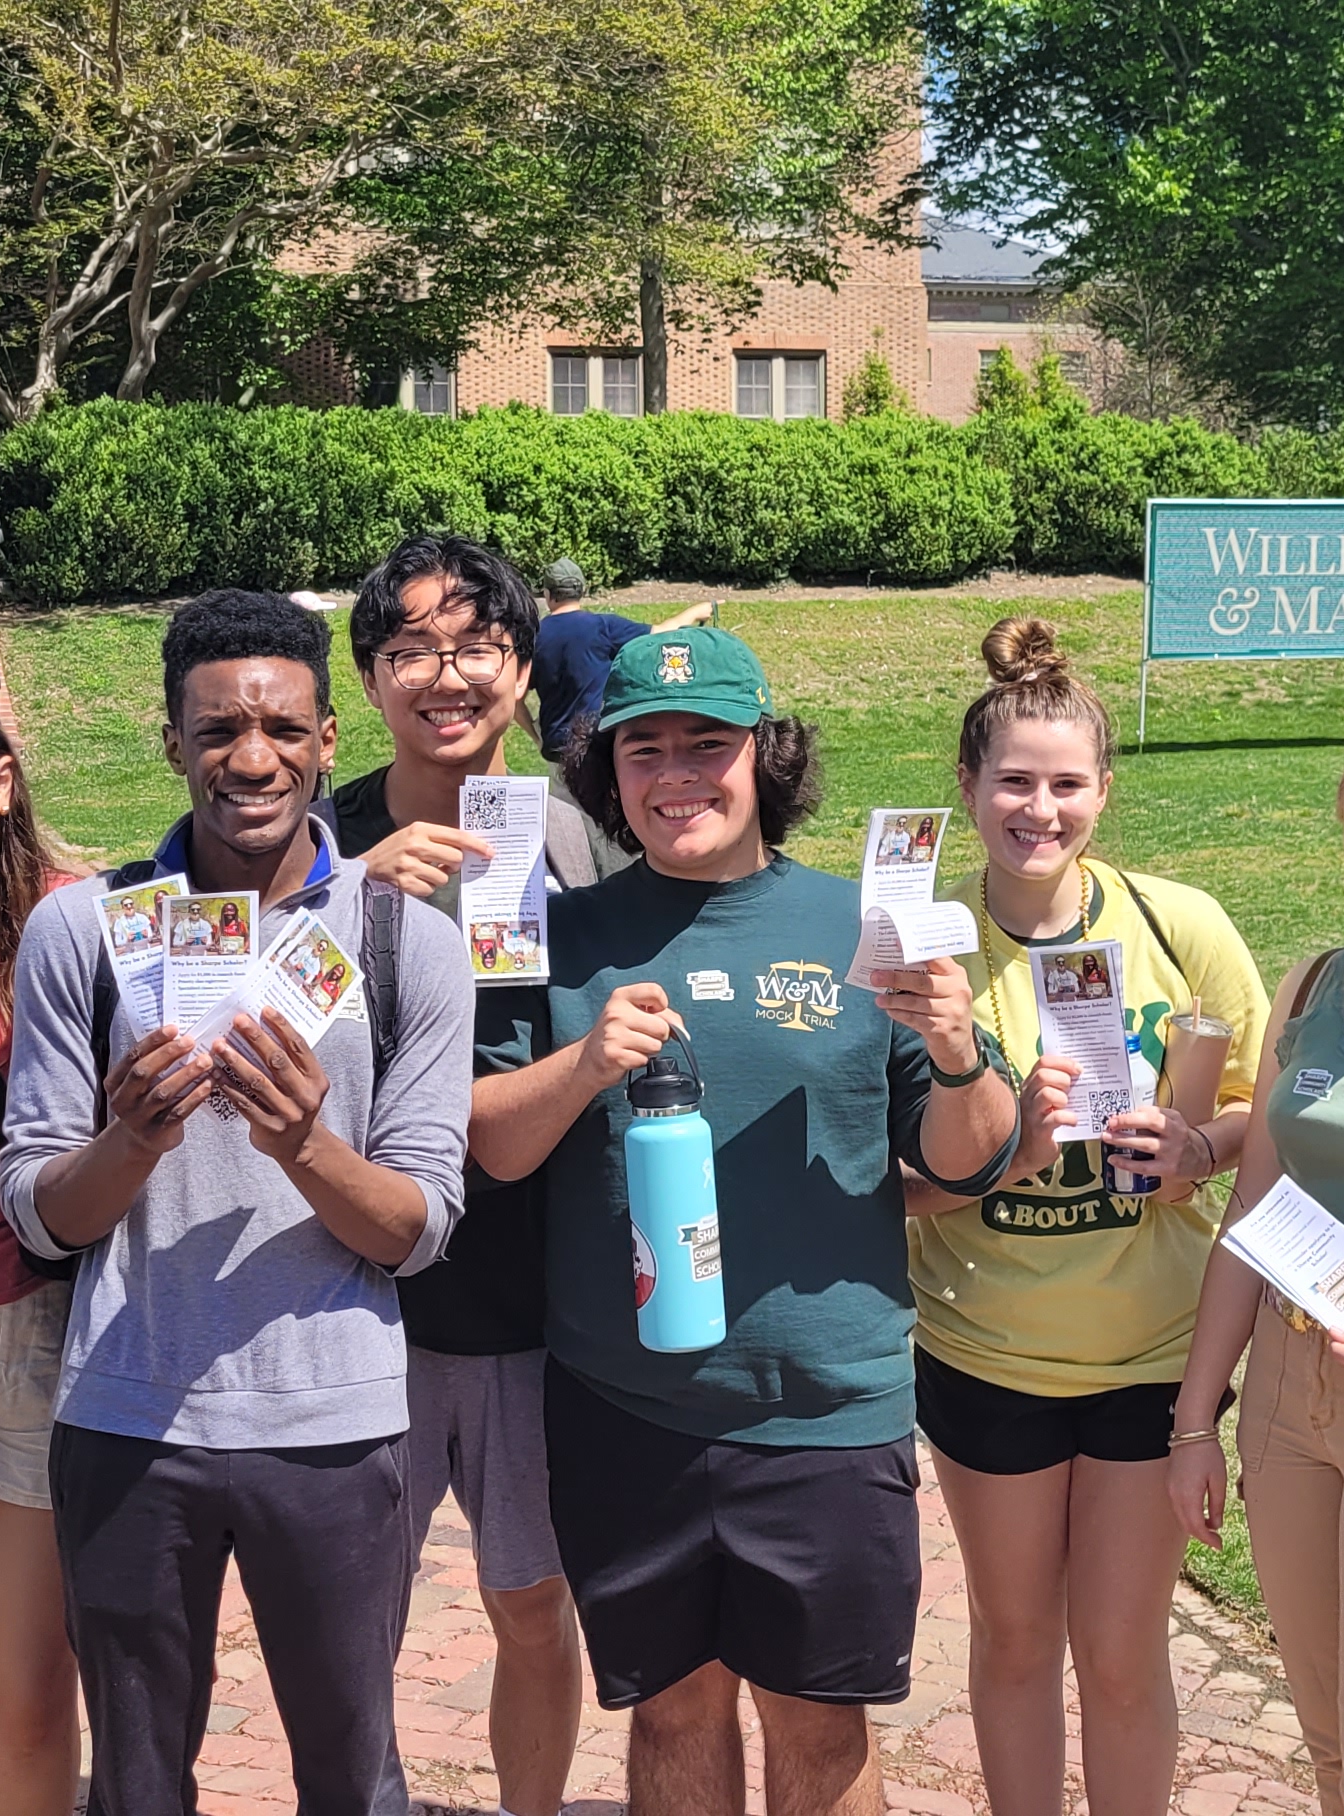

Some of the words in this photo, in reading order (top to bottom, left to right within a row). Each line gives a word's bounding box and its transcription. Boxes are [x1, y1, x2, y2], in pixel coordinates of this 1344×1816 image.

[1208, 587, 1260, 636] &
[756, 1009, 794, 1021] MOCK
[804, 1014, 837, 1030] TRIAL
[994, 1200, 1101, 1229] ABOUT
[697, 1226, 719, 1243] SHA
[697, 1259, 721, 1277] SCHO
